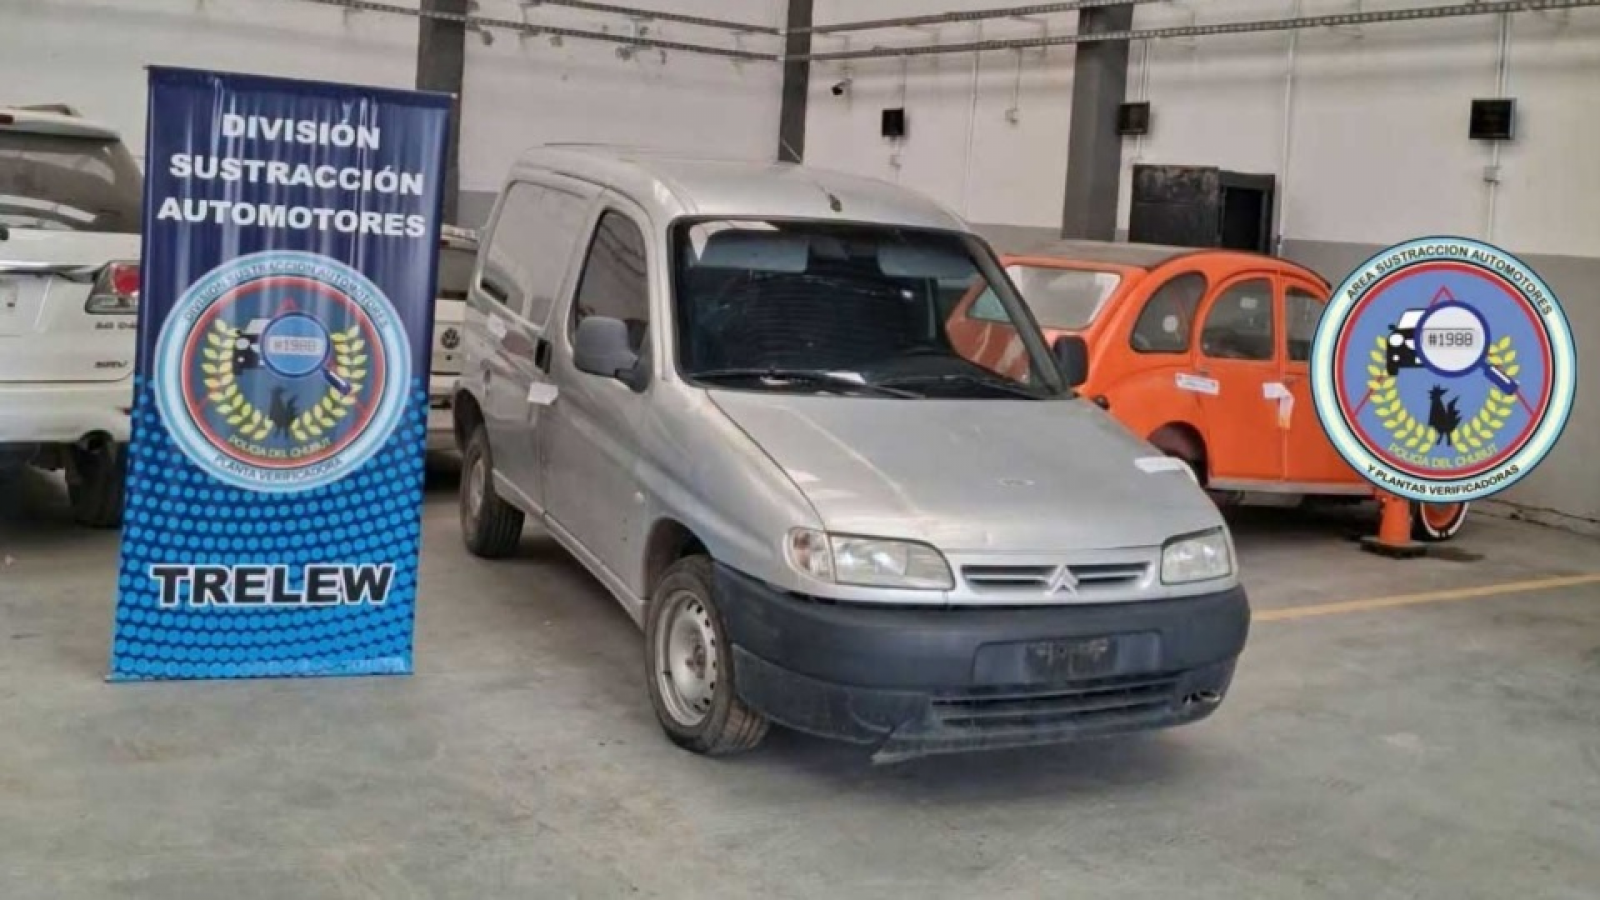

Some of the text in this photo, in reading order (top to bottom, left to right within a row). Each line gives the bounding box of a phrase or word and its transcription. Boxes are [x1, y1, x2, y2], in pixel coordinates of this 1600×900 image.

[222, 114, 380, 150] DIVISIÓN
[169, 153, 424, 195] SUSTRACCIÓN
[157, 197, 426, 237] AUTOMOTORES
[150, 563, 396, 607] TRELEW
